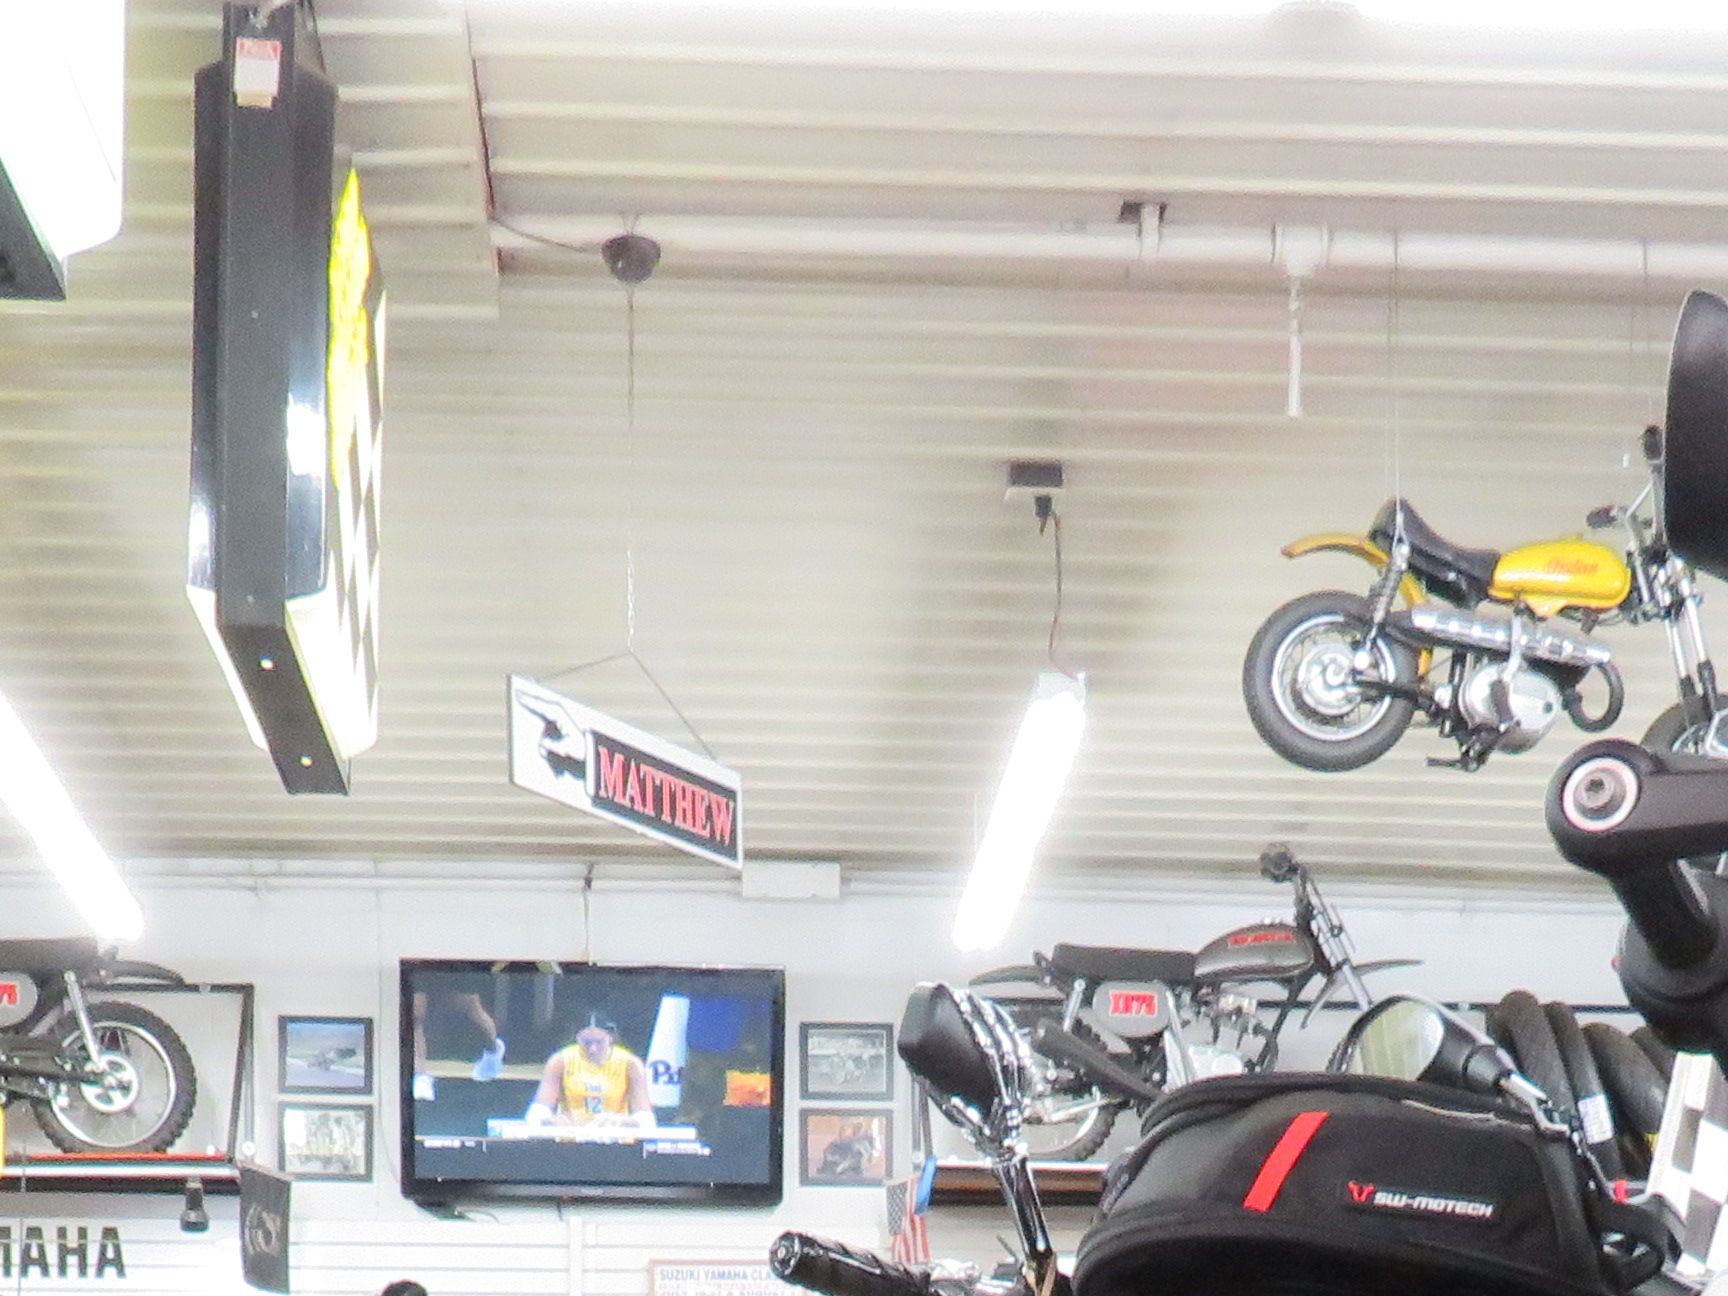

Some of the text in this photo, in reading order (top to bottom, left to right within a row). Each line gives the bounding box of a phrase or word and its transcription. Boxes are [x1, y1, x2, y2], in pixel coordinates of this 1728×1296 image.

[598, 746, 734, 846] MATTHEW
[1373, 1192, 1494, 1218] SW-MOTECH
[660, 1268, 775, 1281] SUZUKI YAMAHA CLA
